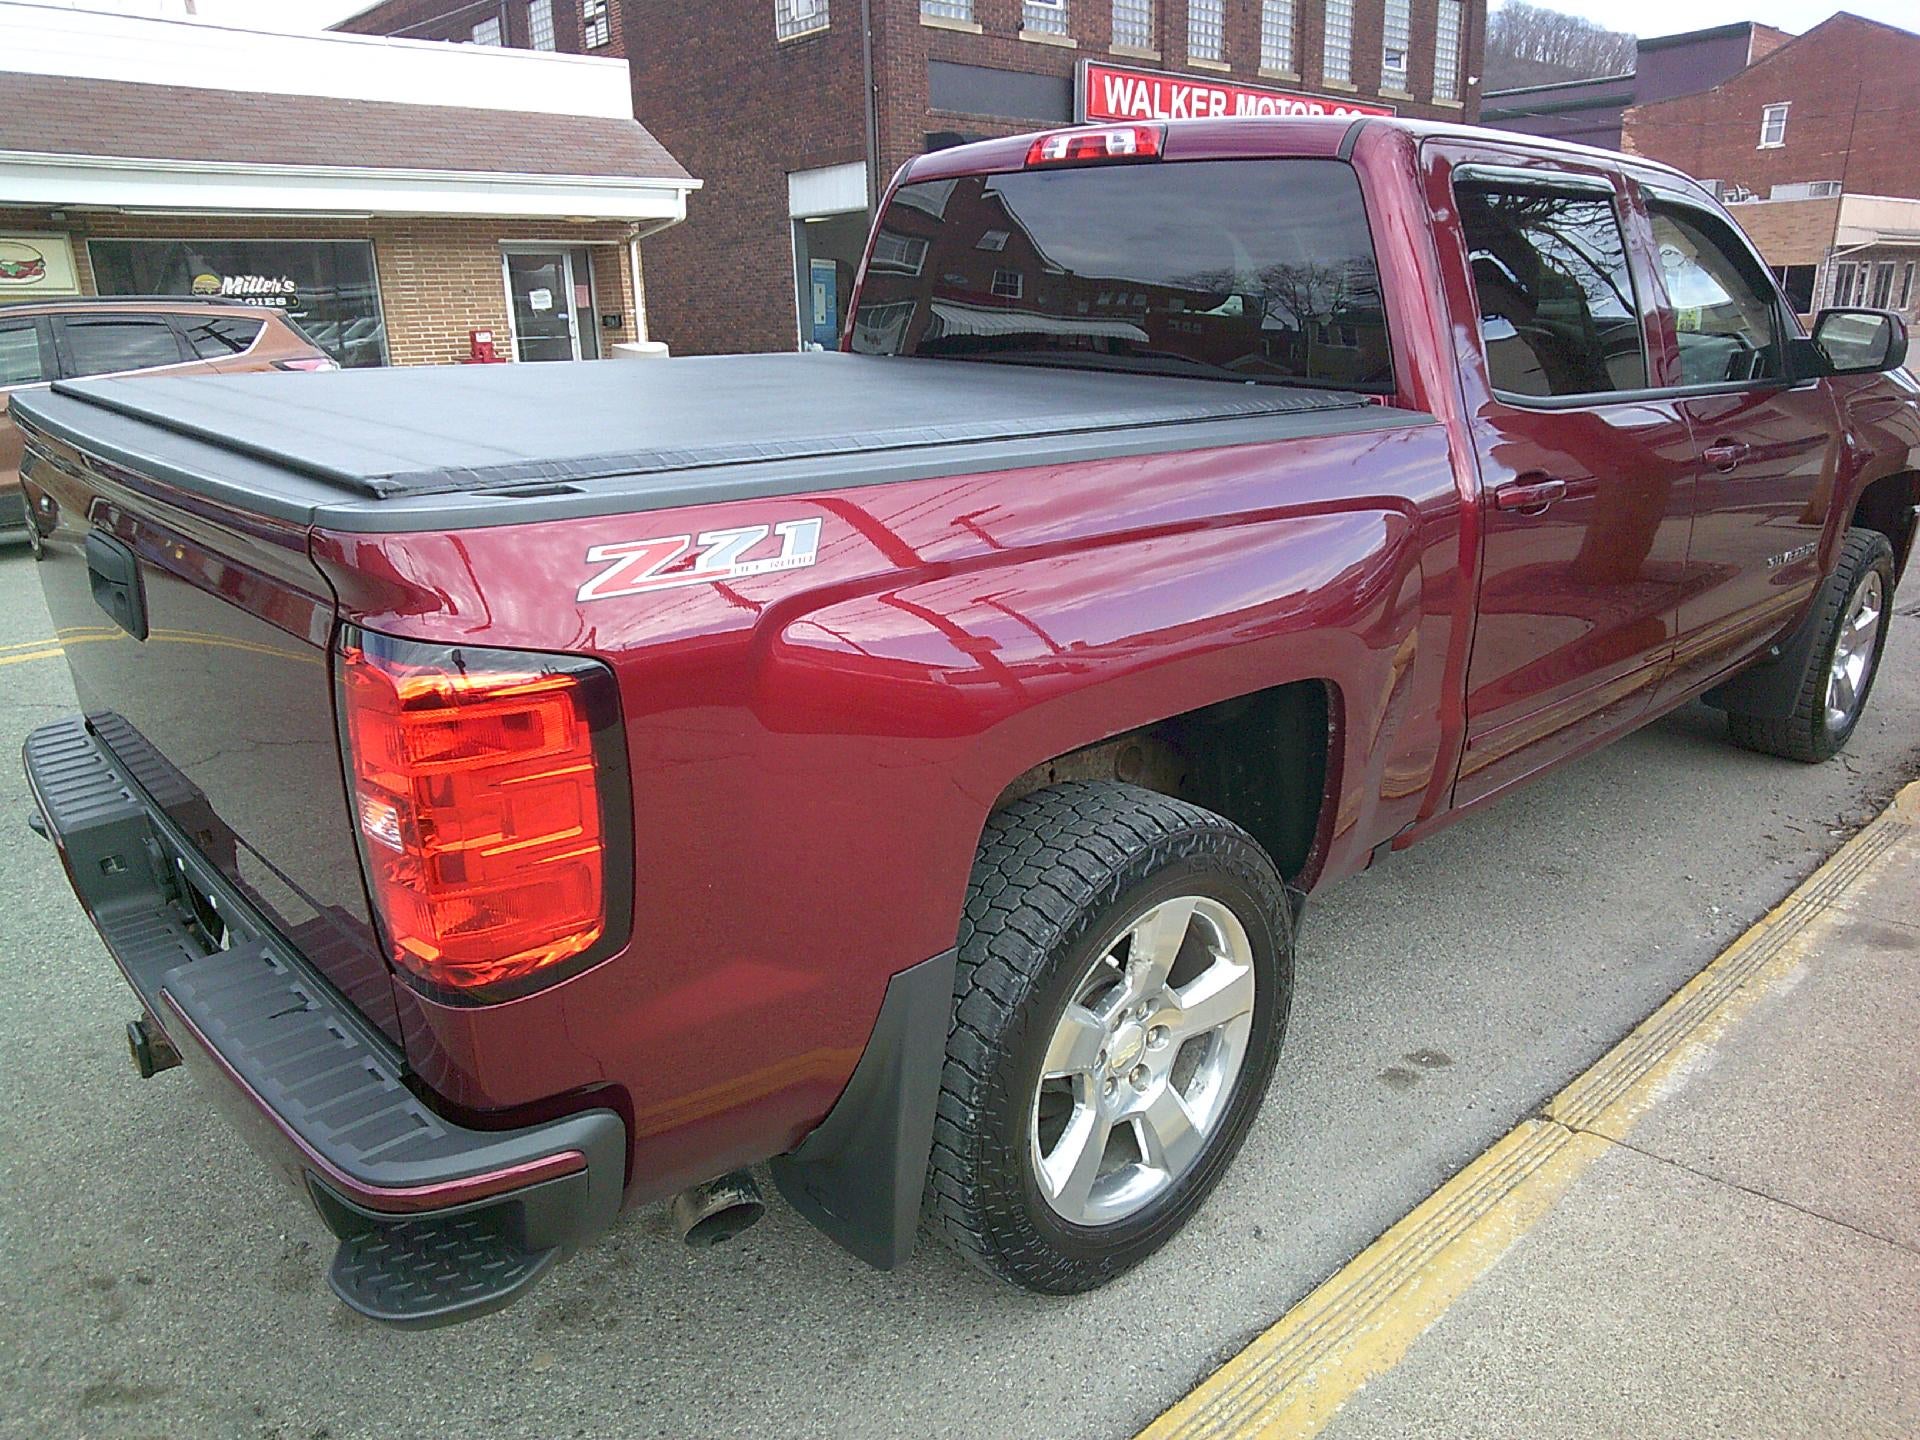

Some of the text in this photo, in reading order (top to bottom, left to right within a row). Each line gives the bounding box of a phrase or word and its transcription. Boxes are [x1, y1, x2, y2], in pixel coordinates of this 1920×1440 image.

[1104, 75, 1227, 119] WALKER
[221, 275, 296, 295] Miller's
[241, 296, 287, 306] GIES
[577, 518, 822, 602] Z71
